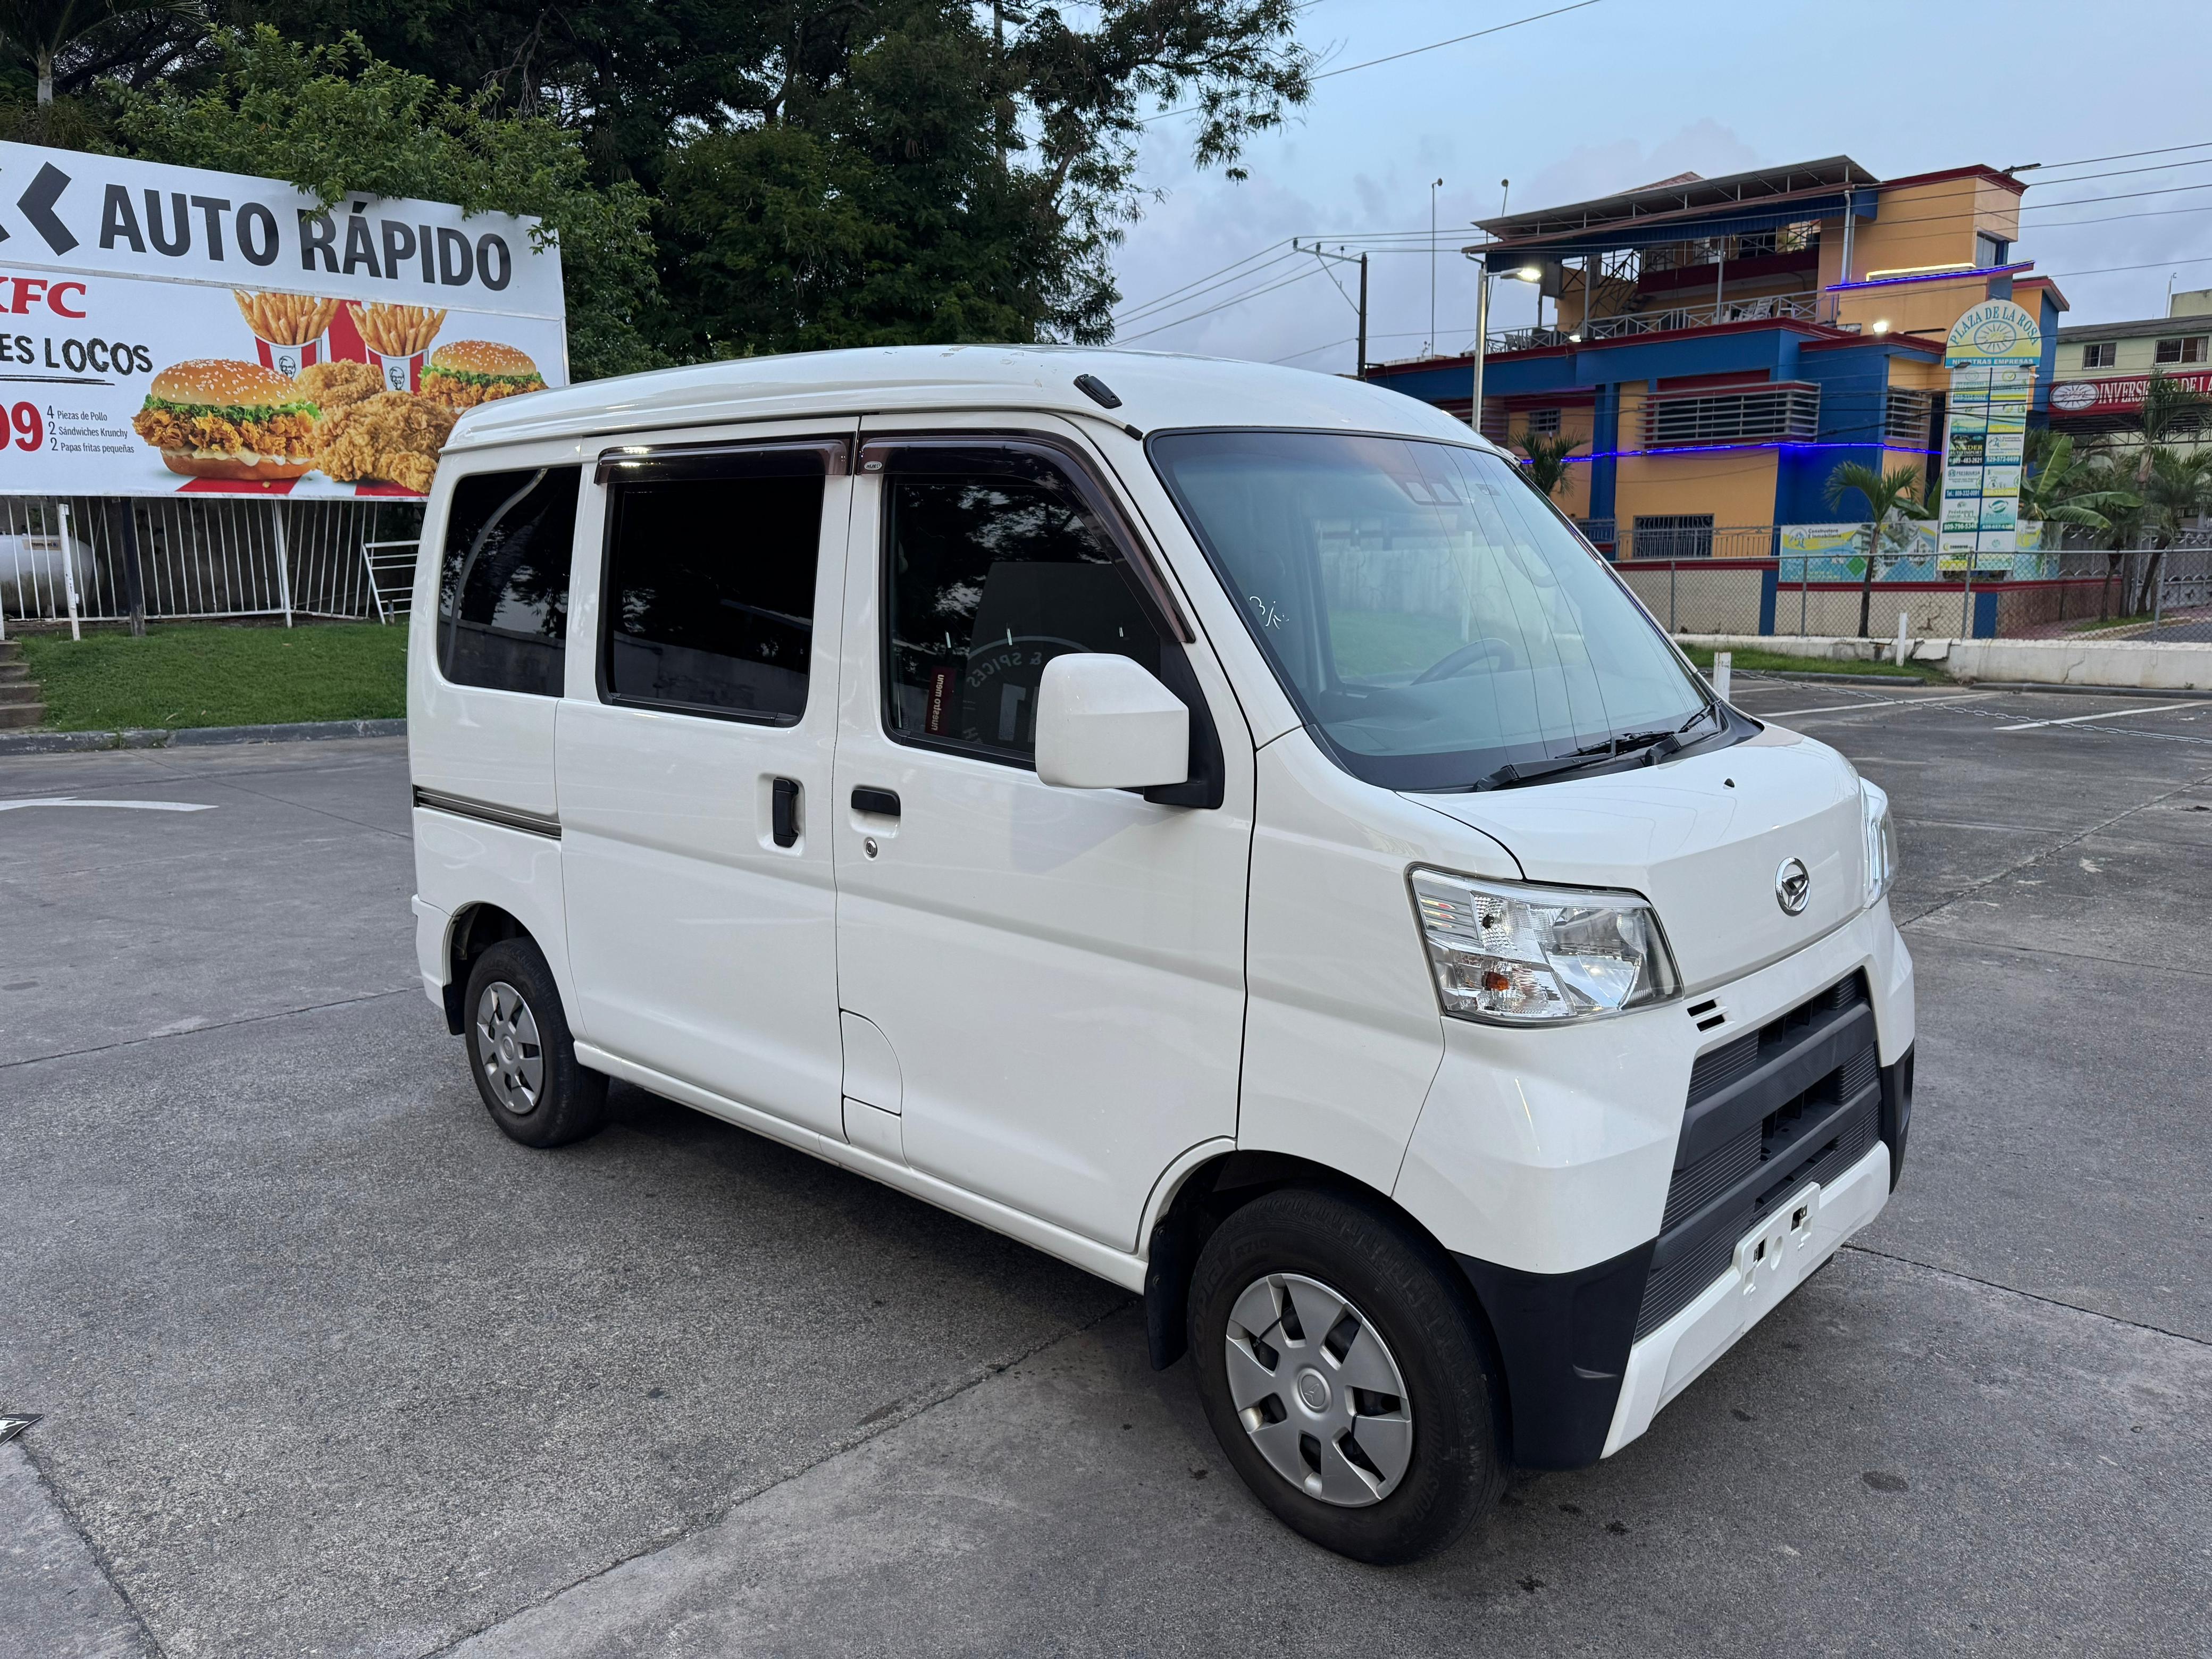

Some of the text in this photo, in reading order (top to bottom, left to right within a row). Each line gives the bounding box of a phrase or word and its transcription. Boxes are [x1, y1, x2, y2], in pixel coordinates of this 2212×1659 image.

[99, 183, 512, 291] AUTO RÁPIDO
[1949, 306, 2040, 346] PLAZA DE LA ROSA
[44, 338, 153, 376] LOCOS
[47, 405, 107, 421] 4 Piezas de Pollo
[48, 421, 128, 439] 2 Sándwiches Krunchy
[50, 437, 135, 454] 2 Papas fritas pequeñas
